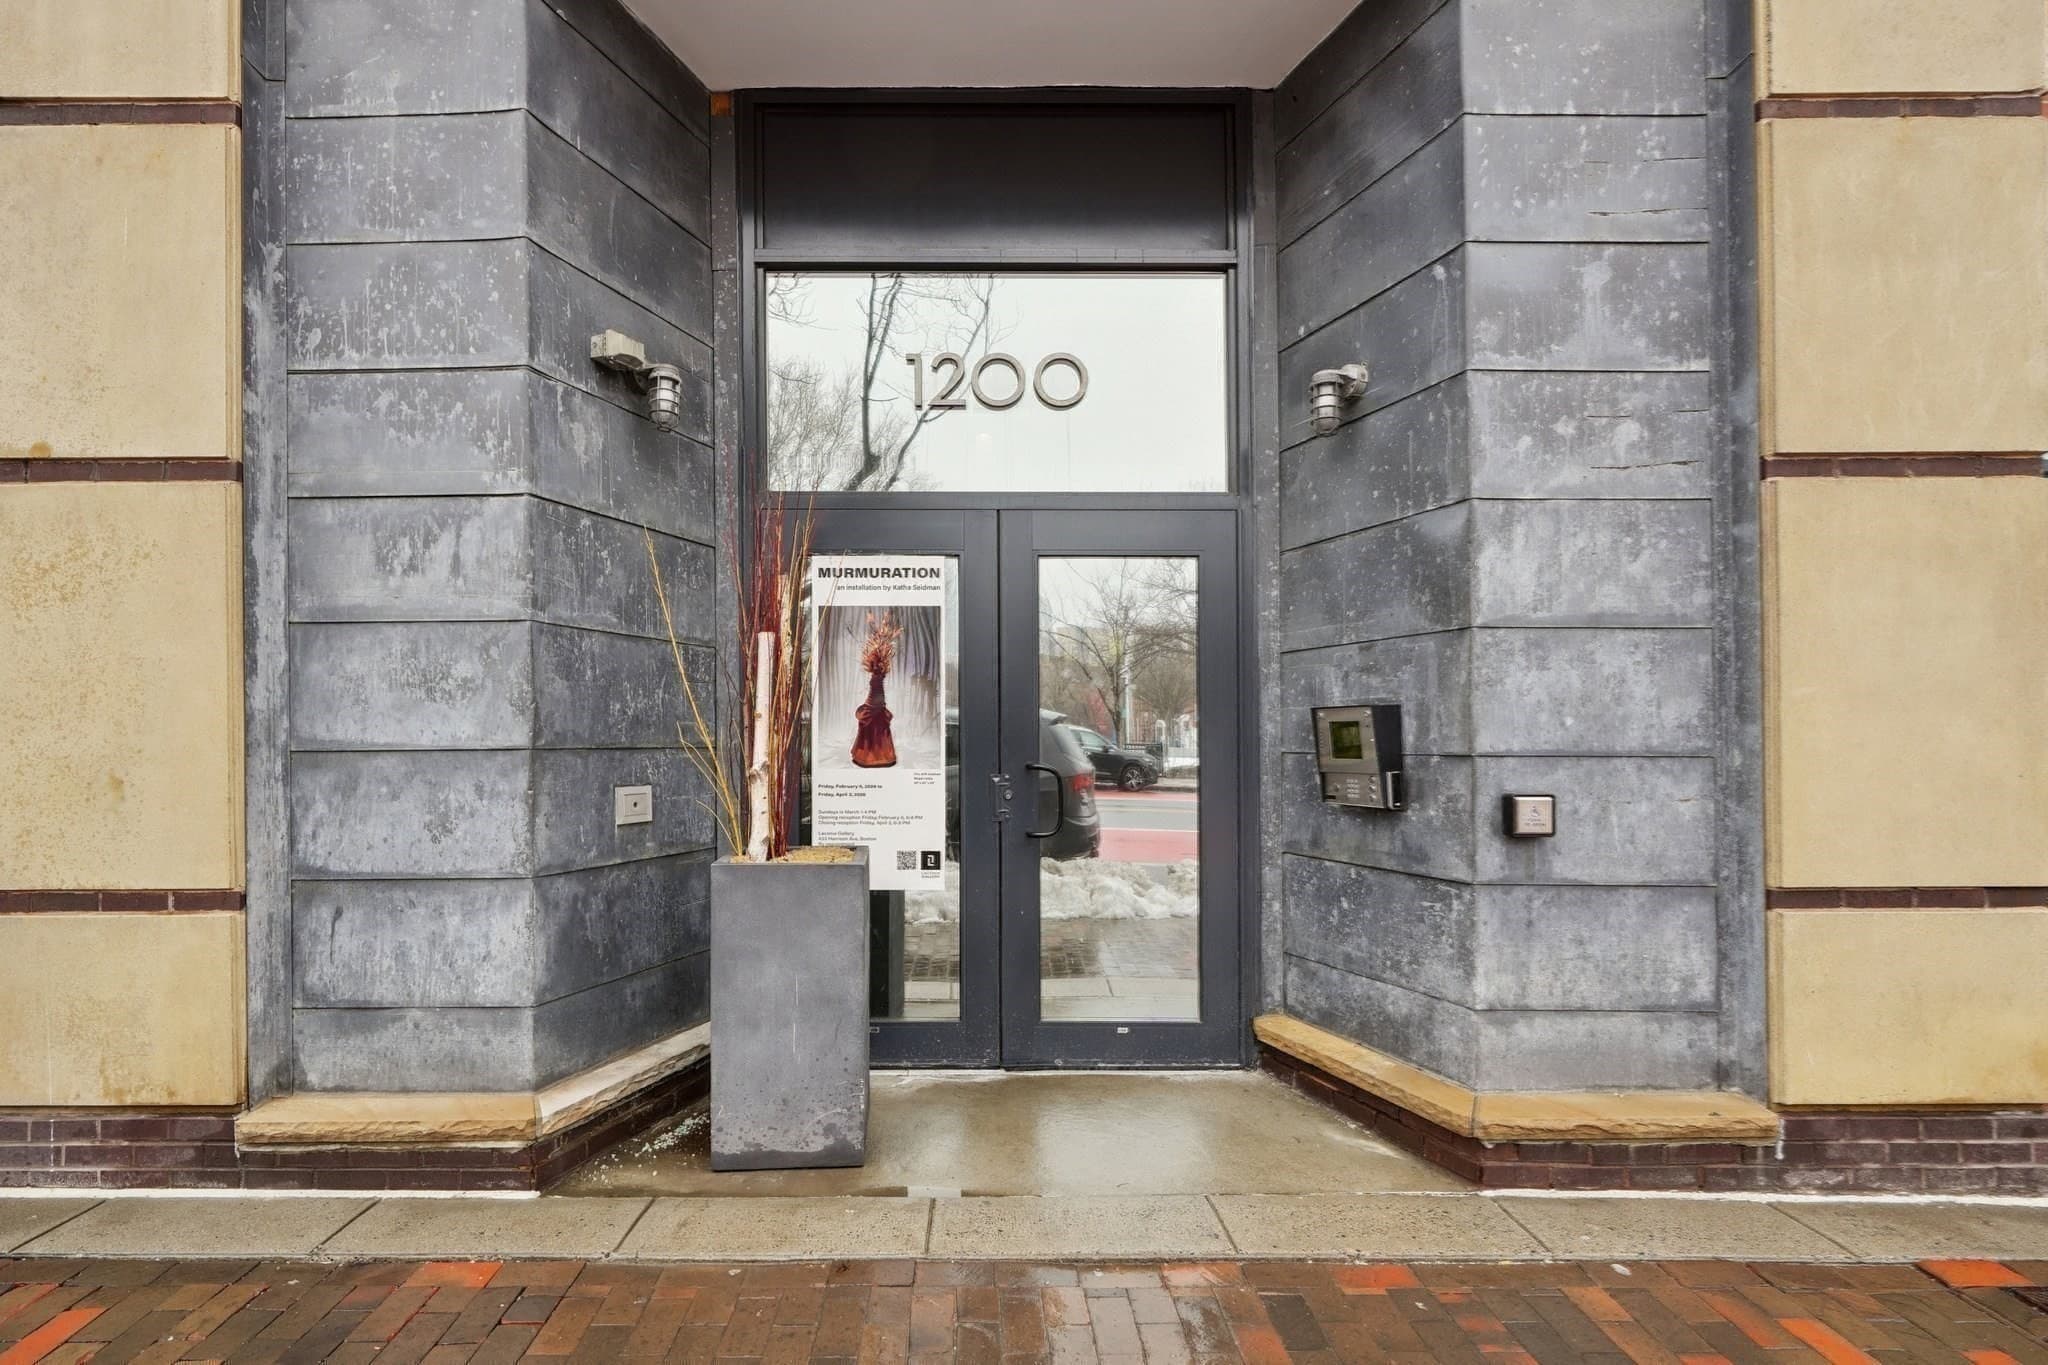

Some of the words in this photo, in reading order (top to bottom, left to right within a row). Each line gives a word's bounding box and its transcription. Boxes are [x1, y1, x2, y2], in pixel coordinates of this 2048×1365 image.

[906, 352, 1088, 411] 1200
[818, 567, 940, 579] MURMURATION
[883, 584, 891, 592] by
